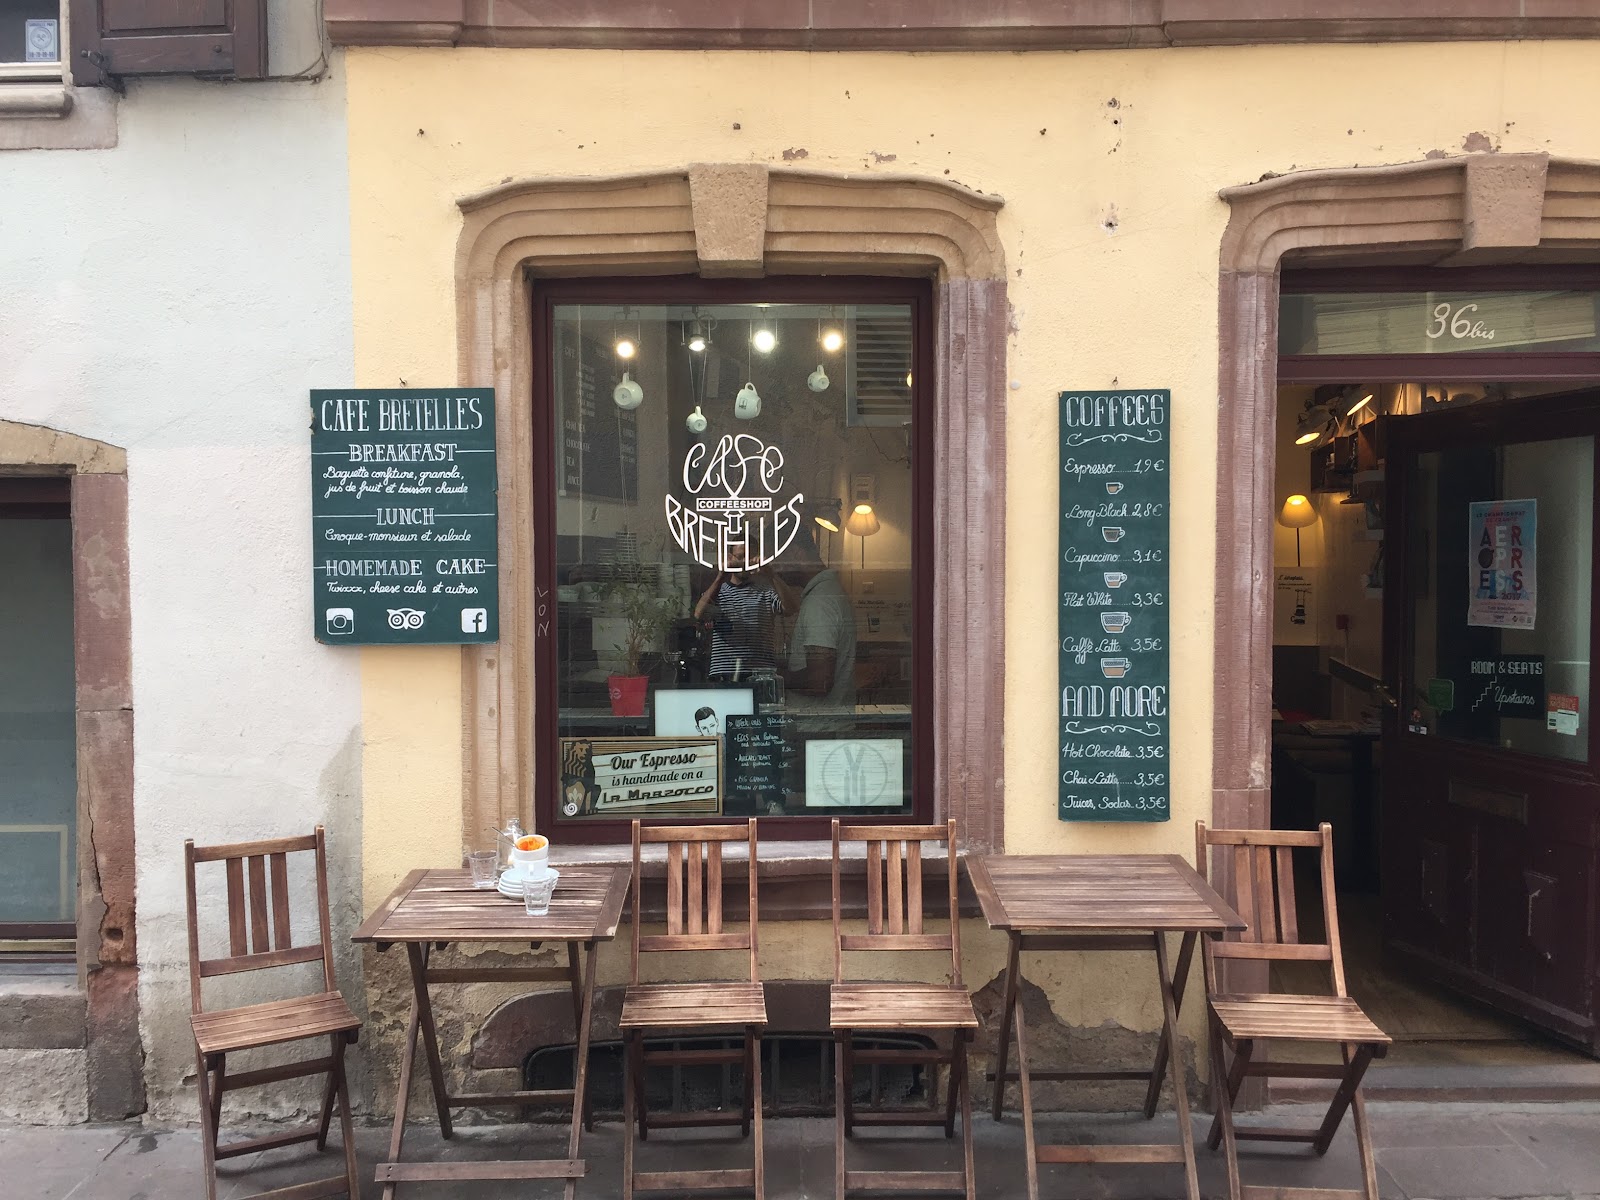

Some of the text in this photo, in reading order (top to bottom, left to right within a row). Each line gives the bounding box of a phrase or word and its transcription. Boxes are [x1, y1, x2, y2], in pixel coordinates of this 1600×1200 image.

[322, 397, 482, 432] CAFE BRETELLES
[1066, 394, 1164, 427] COFFEES
[349, 444, 458, 462] BREAKFAST
[323, 465, 464, 486] Baguette confiture, granola,
[1064, 458, 1116, 482] Espresso
[324, 480, 468, 499] jus de fruit et boisson chaude
[699, 500, 770, 509] COFFEESHOP
[376, 508, 434, 525] LUNCH
[1065, 503, 1162, 527] Long Black 2,8€
[325, 528, 471, 544] Croque-monsieur et salade
[666, 493, 804, 572] BRETELLES
[1132, 550, 1162, 564] 3,1€
[326, 558, 486, 576] HOMEMADE CAKE
[370, 580, 400, 594] cheese
[403, 580, 426, 594] cake
[431, 582, 441, 594] et
[446, 582, 478, 594] autres
[1063, 592, 1164, 608] Flat White 3,3€
[1095, 638, 1122, 652] Latte
[1130, 638, 1162, 652] 3,5€
[1471, 661, 1542, 675] ROOM & SEATS
[1062, 686, 1166, 717] AND MORE
[1495, 686, 1534, 711] Upstairs
[1062, 742, 1164, 759] Hot Chocolate 3,5€
[610, 752, 698, 770] Our Espresso
[612, 776, 620, 787] is
[622, 771, 680, 786] handmade
[696, 770, 703, 778] a
[1062, 770, 1164, 787] Chai Latte 3,5€
[1062, 795, 1166, 810] Juices, Sodas 3,5€
